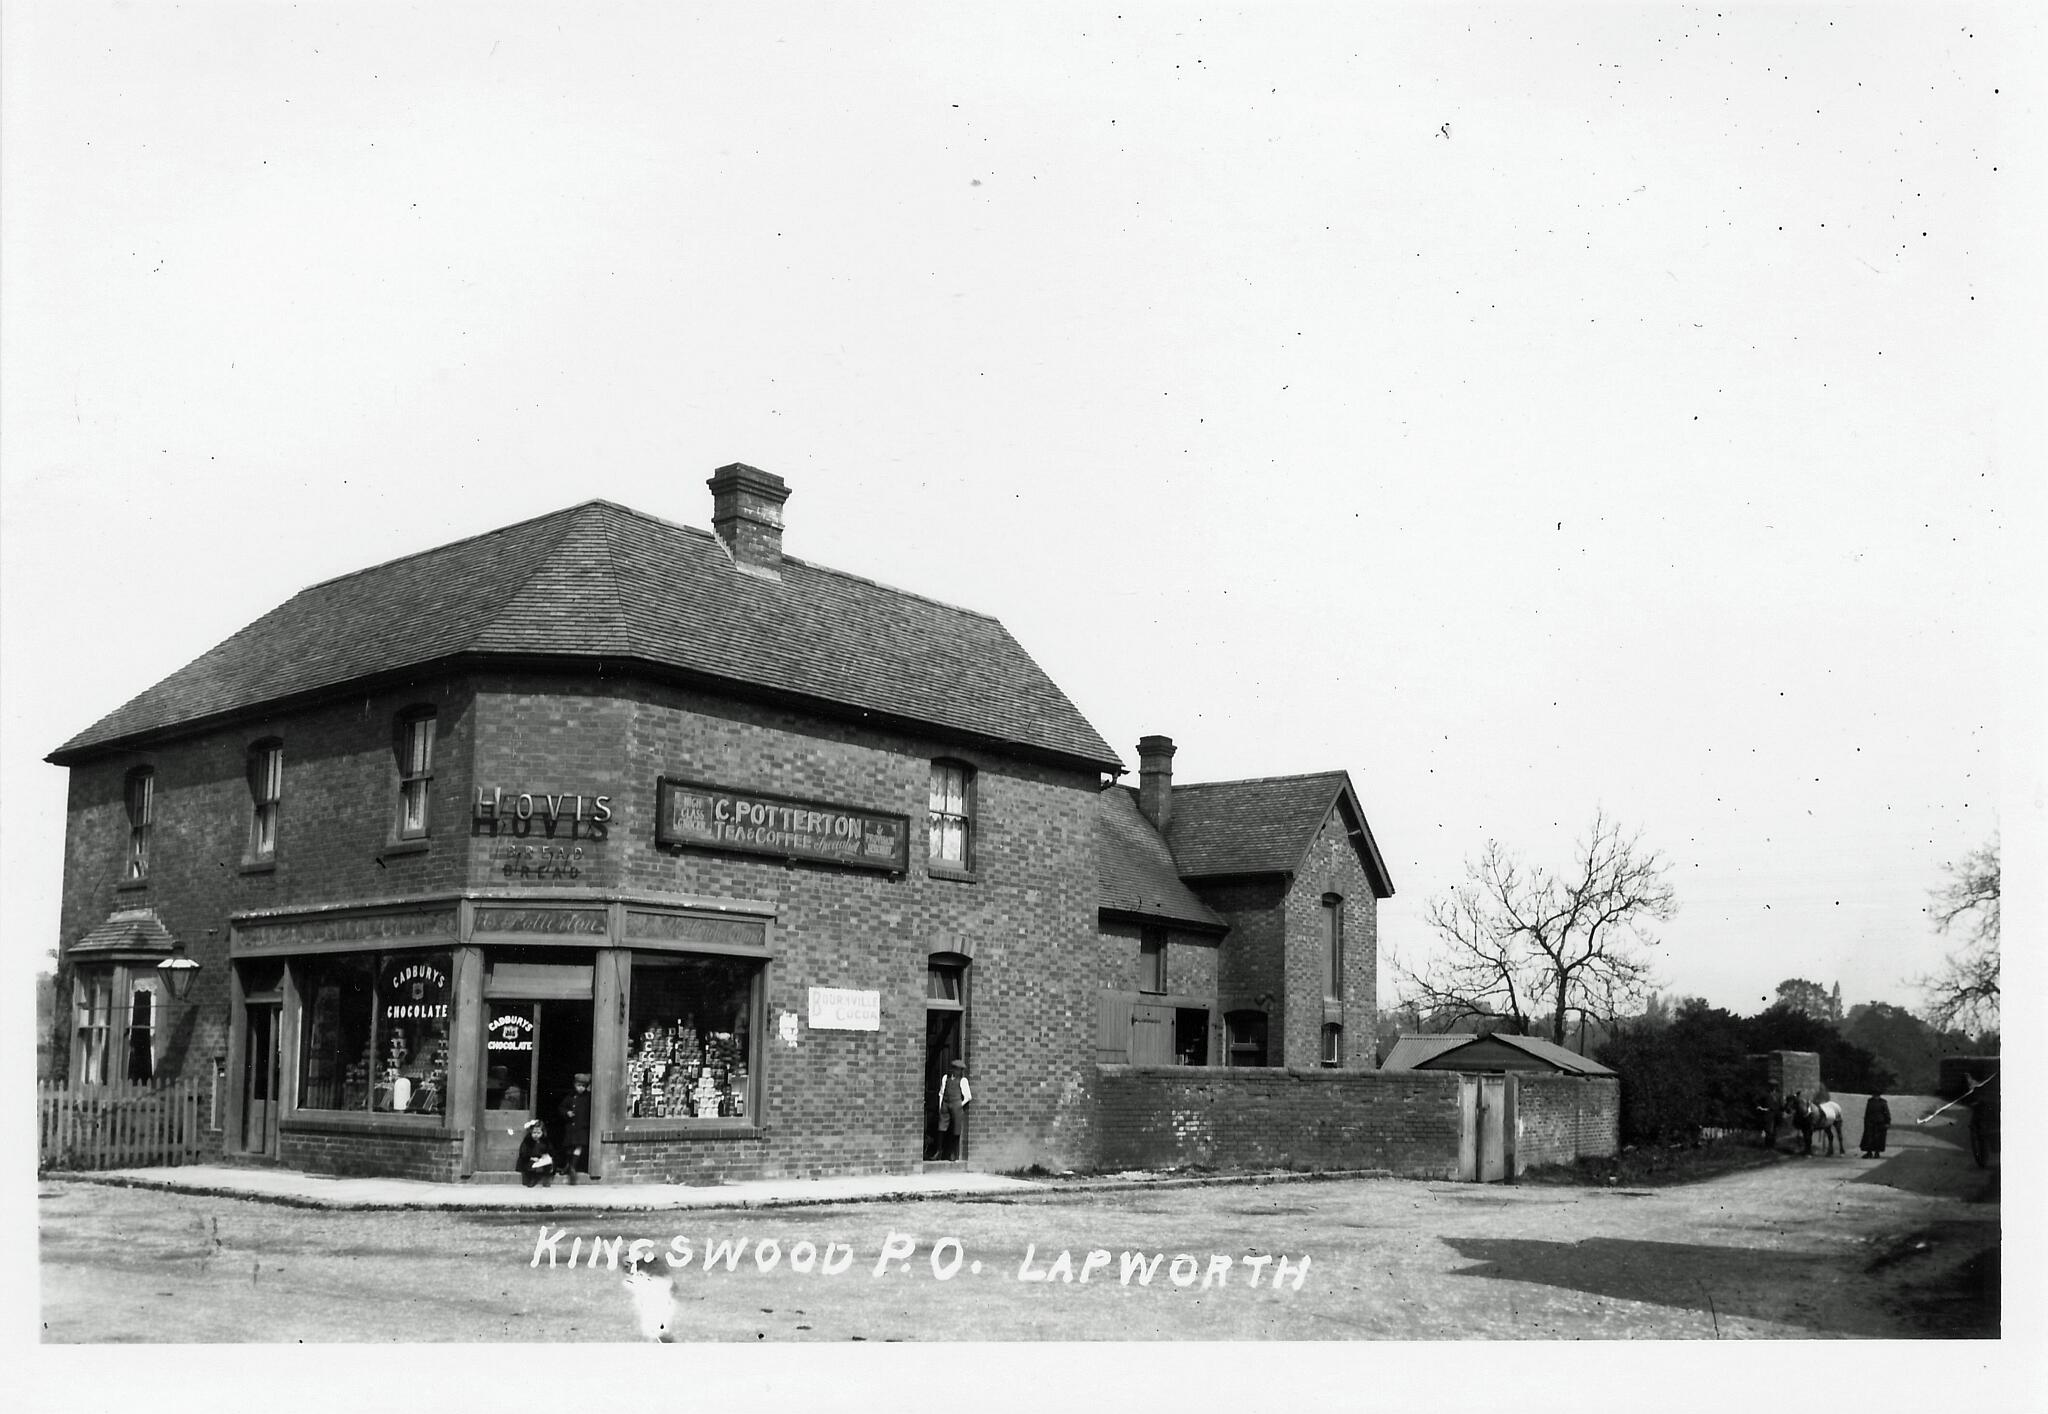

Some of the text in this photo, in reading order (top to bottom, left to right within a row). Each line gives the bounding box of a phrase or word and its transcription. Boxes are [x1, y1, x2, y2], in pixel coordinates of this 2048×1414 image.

[475, 786, 612, 822] HOVIS
[681, 807, 704, 820] CLASS
[507, 844, 584, 861] BREAD
[387, 1004, 448, 1019] CHOCOLATE
[487, 1040, 533, 1051] CHOCOLATE
